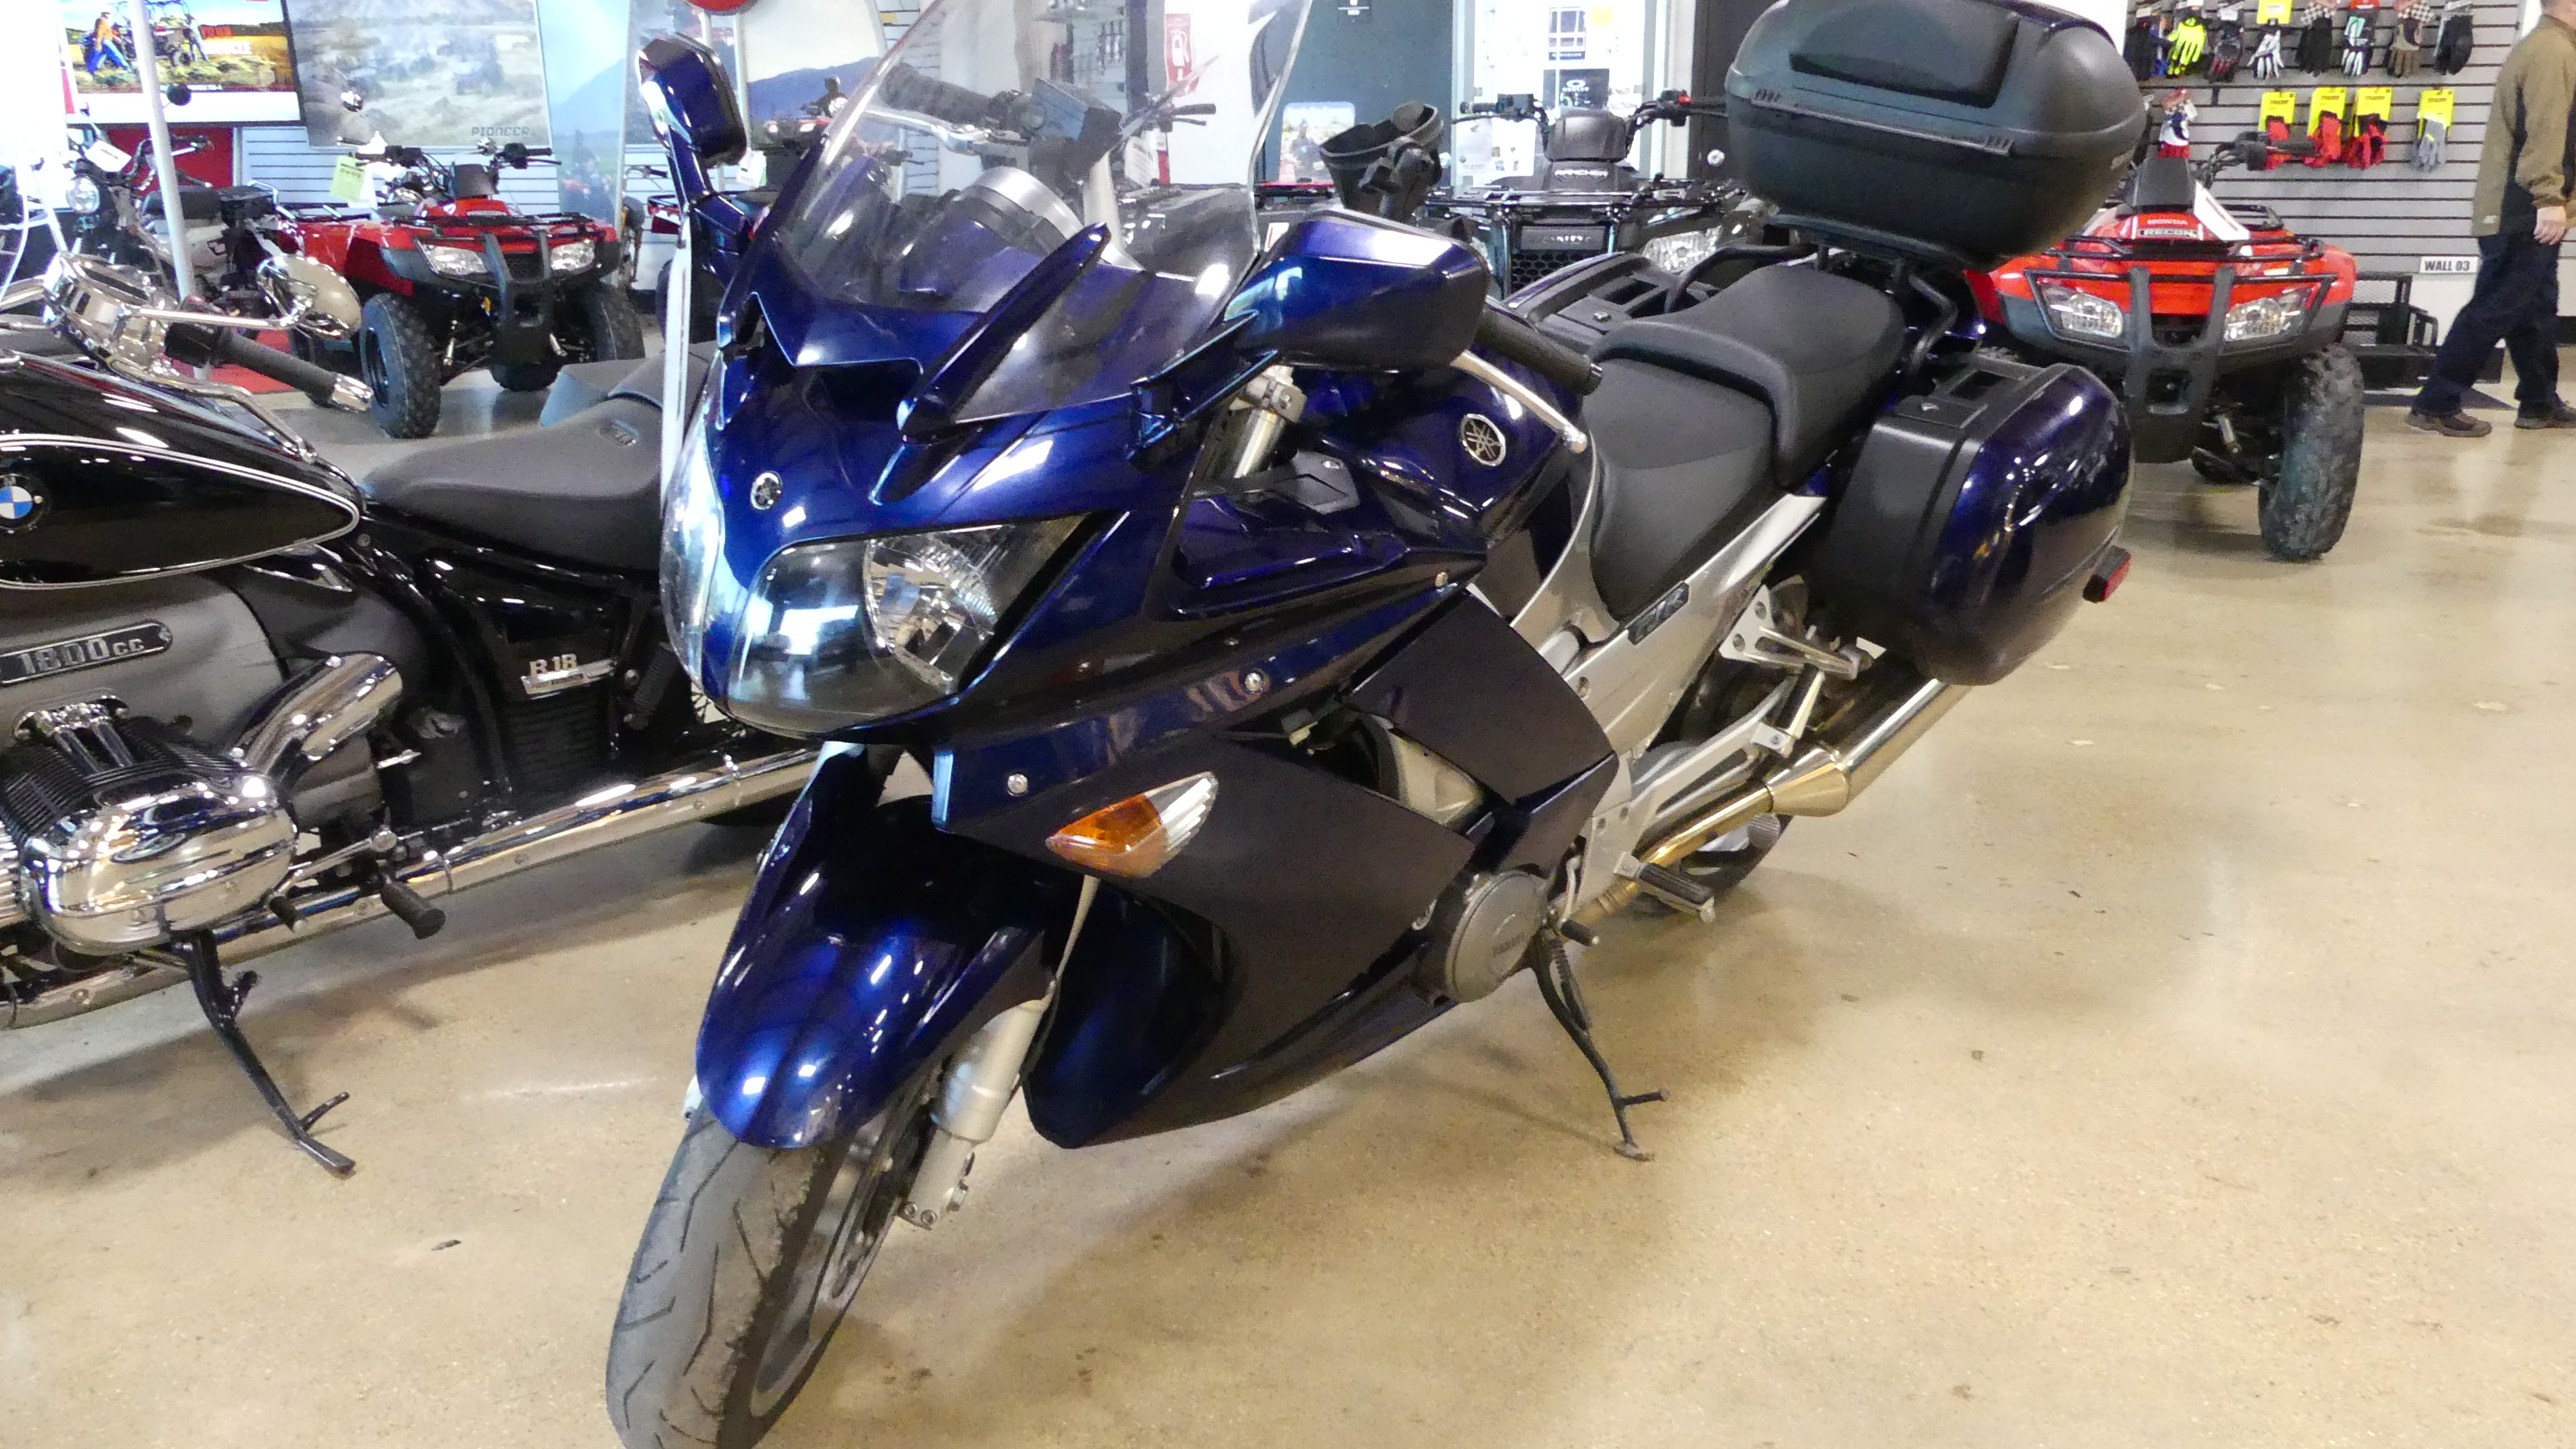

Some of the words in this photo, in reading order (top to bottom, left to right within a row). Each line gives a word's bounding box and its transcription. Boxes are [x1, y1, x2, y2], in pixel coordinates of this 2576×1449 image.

[471, 126, 531, 137] PIONEER
[2143, 227, 2199, 238] RECON
[2424, 260, 2453, 272] WALL
[2455, 260, 2471, 272] 03
